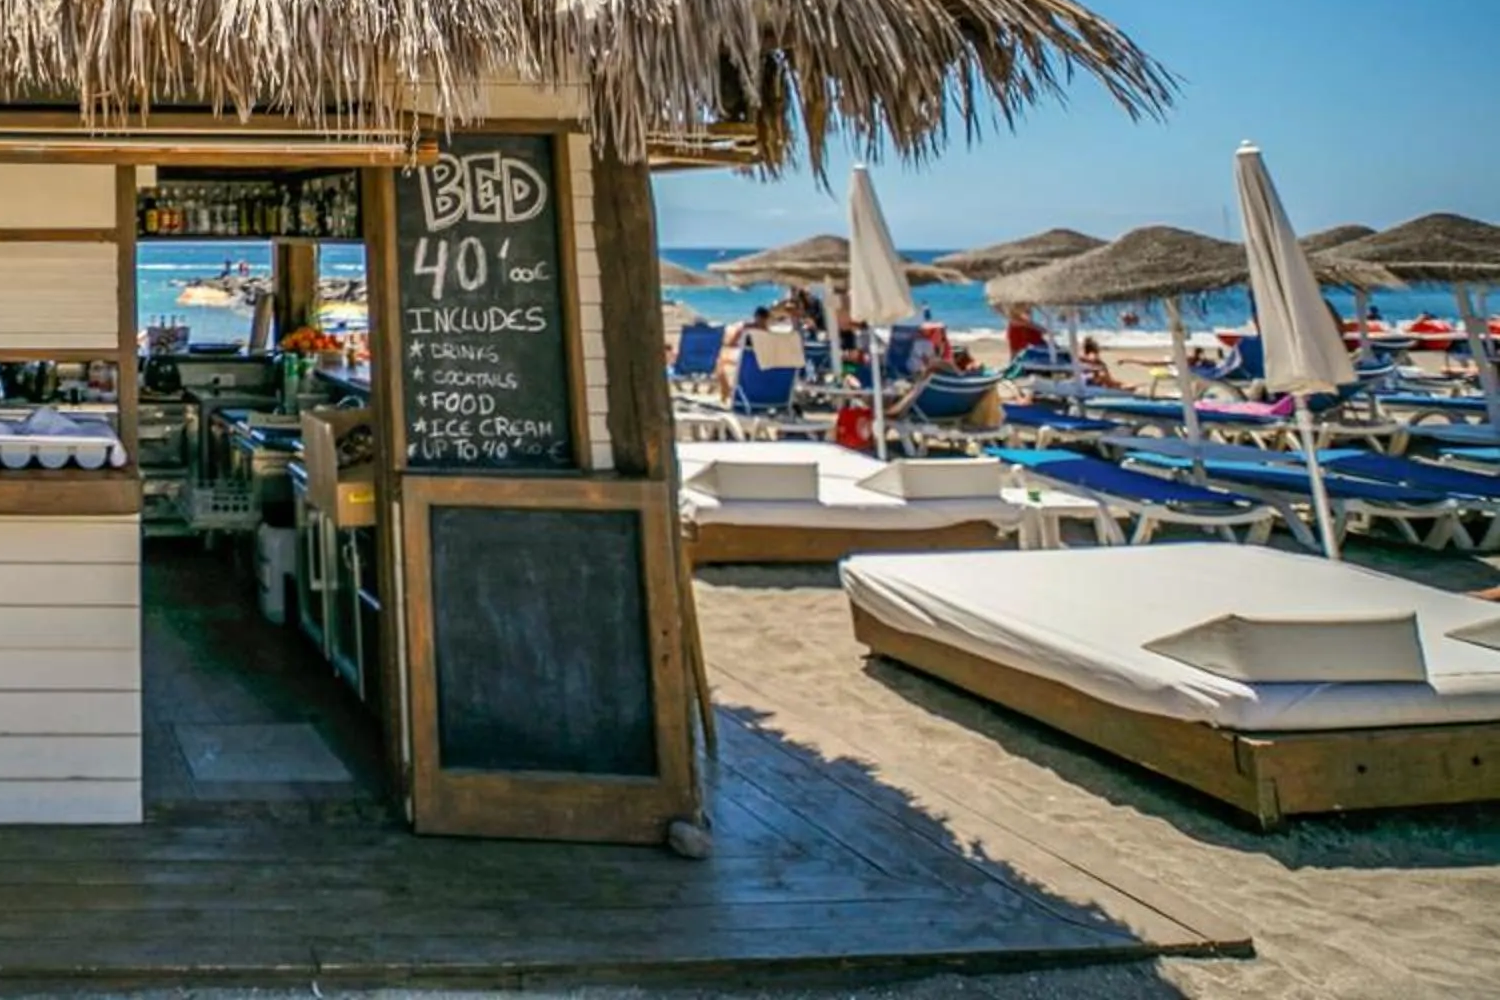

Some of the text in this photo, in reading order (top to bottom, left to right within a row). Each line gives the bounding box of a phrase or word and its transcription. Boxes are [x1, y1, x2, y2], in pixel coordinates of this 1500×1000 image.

[419, 151, 548, 231] BED
[406, 306, 548, 333] INCLUDES
[430, 342, 499, 363] DRINKS
[433, 370, 518, 389] COCKTAILS
[431, 391, 496, 415] FOOD
[429, 417, 552, 438] ICE CREAM
[422, 440, 448, 460] UP
[453, 439, 478, 460] TO
